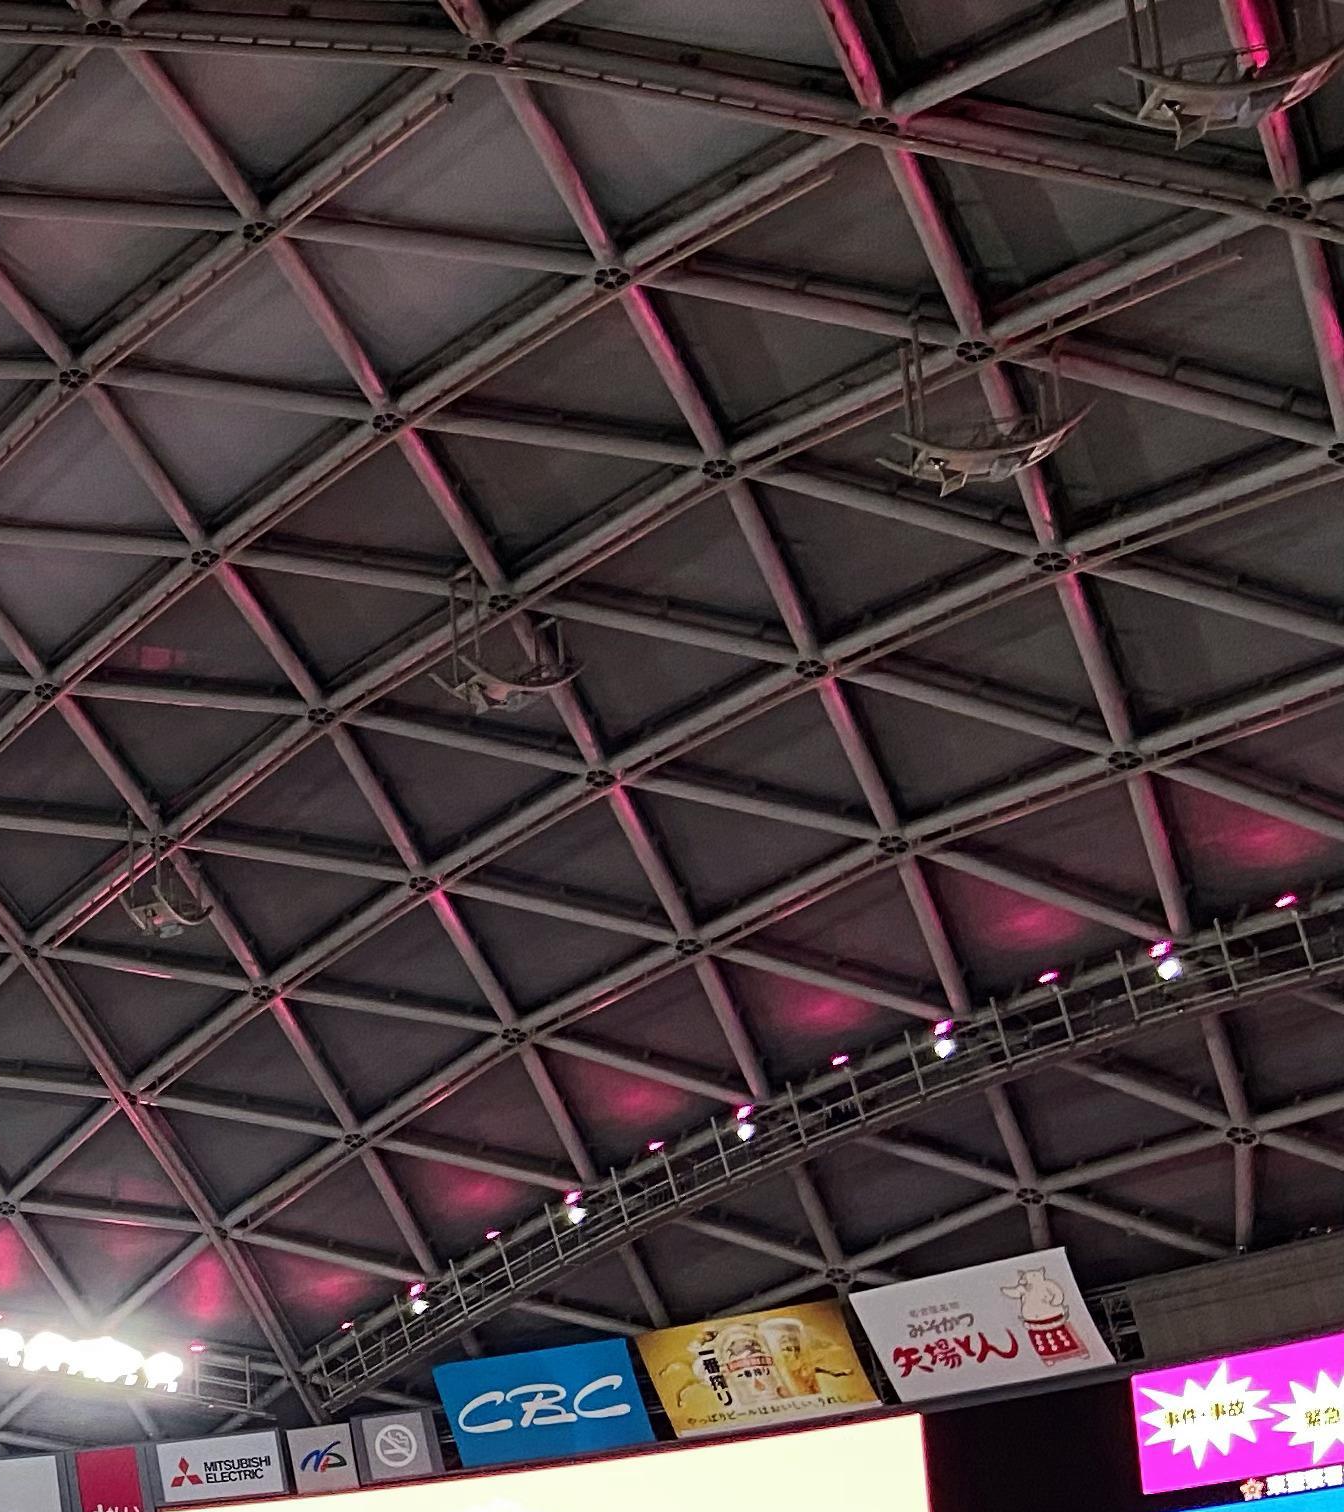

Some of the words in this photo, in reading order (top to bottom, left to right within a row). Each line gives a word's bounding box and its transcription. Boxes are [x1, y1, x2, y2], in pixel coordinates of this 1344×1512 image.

[893, 1328, 1018, 1377] 矢場とん
[698, 1349, 733, 1406] 一番搾り
[458, 1375, 632, 1434] CBC
[203, 1455, 272, 1473] MITSUBISHI
[205, 1468, 265, 1484] ELECTRIC
